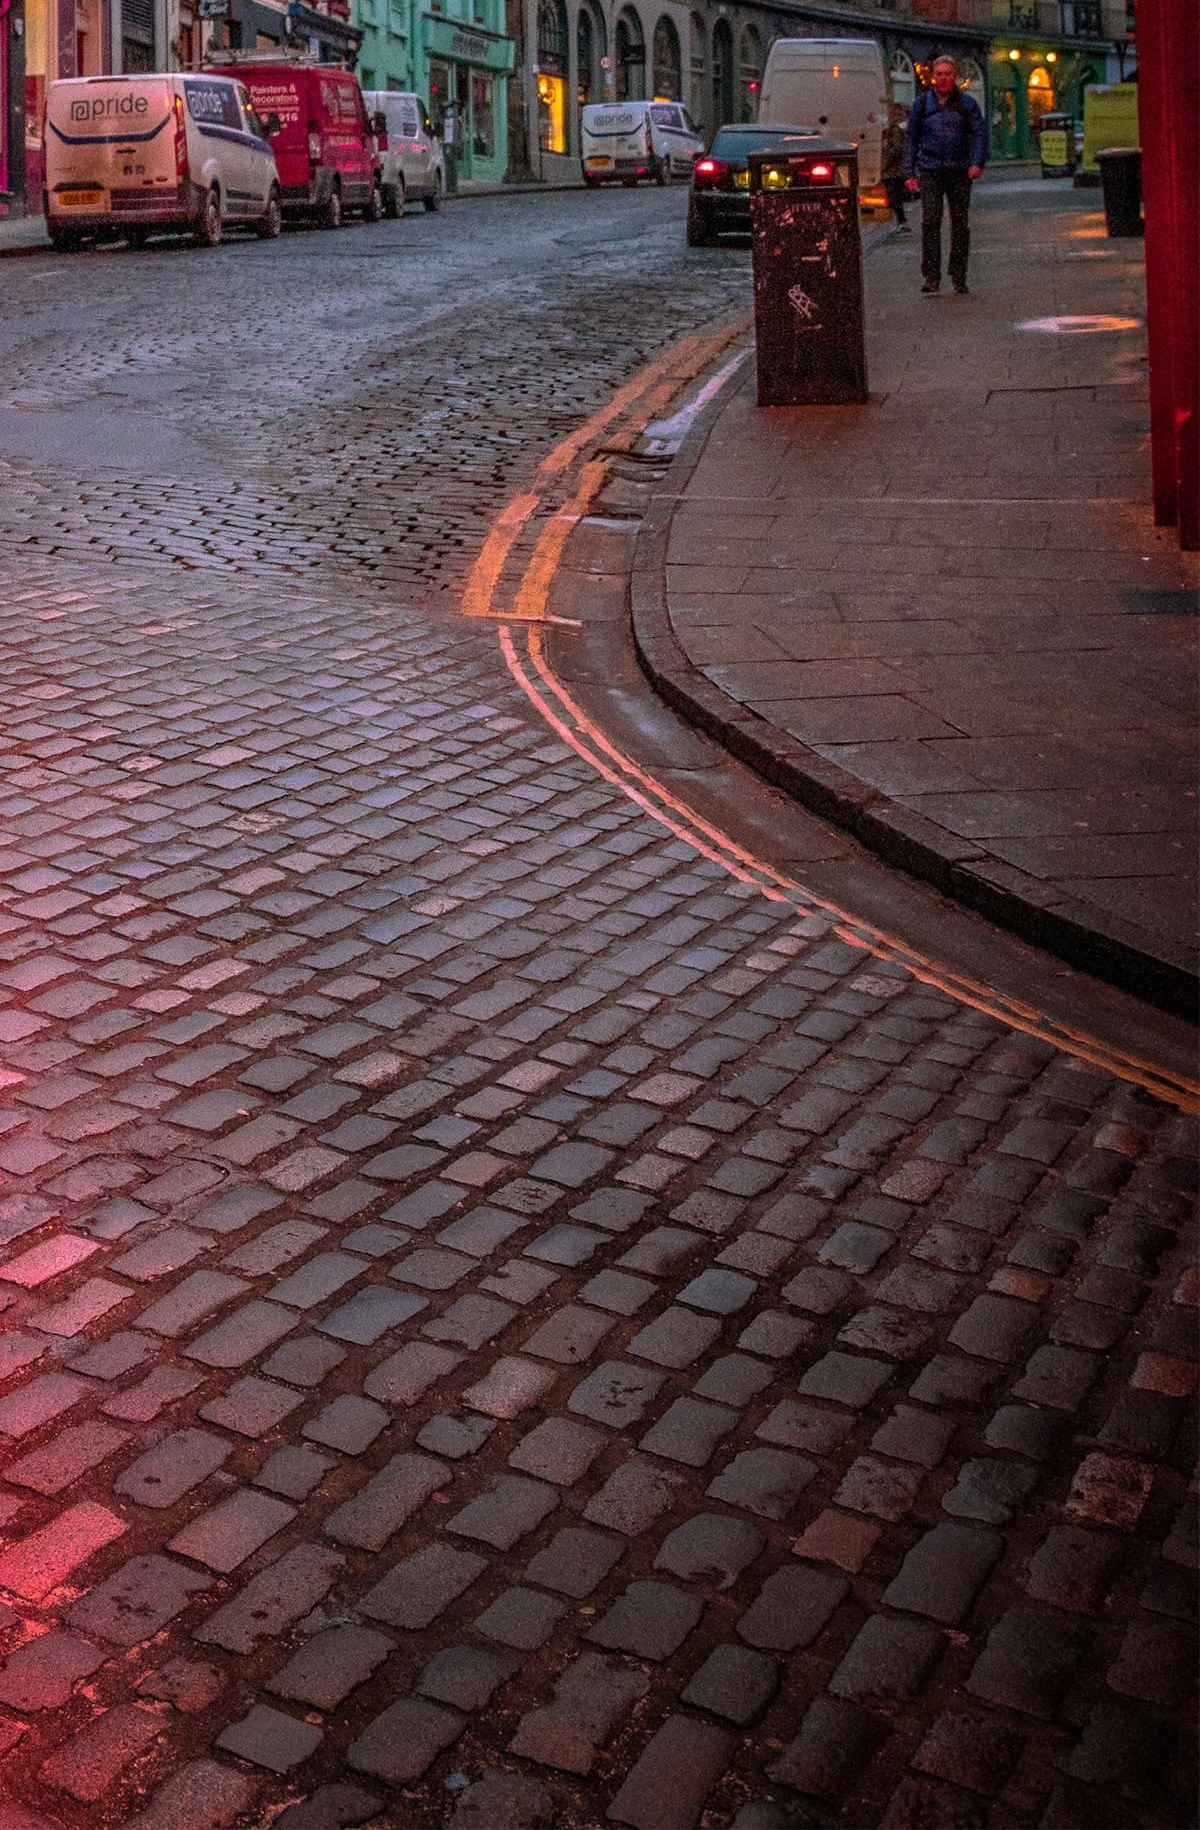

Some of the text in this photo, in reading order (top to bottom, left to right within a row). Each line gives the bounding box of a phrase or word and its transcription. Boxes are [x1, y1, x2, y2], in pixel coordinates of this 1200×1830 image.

[250, 83, 297, 95] Painters &
[92, 92, 148, 120] pride
